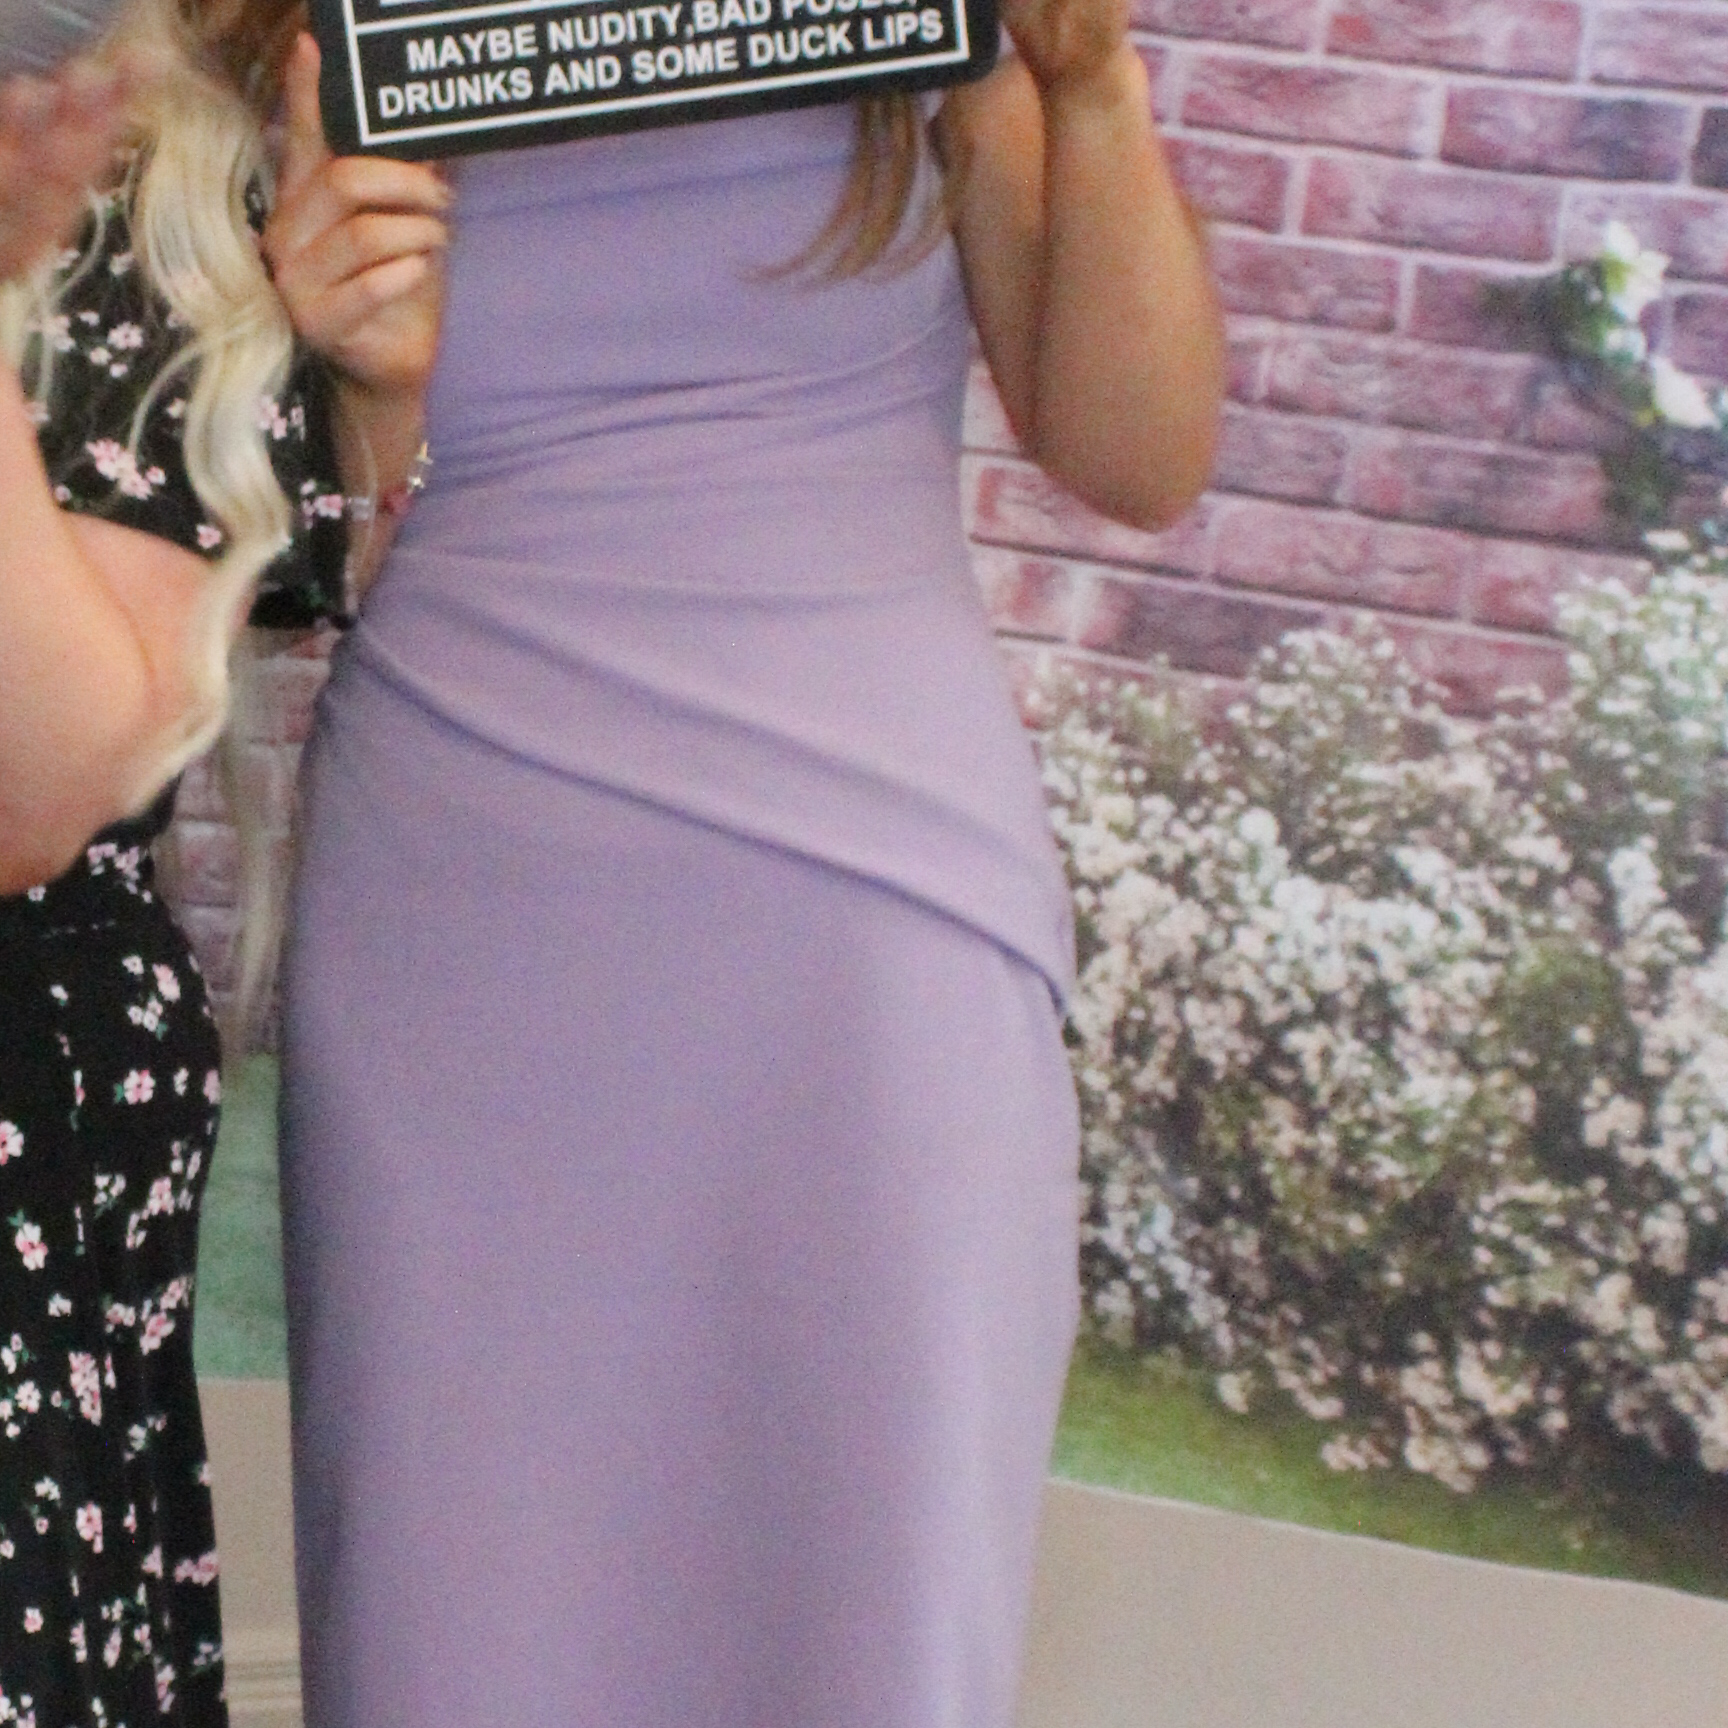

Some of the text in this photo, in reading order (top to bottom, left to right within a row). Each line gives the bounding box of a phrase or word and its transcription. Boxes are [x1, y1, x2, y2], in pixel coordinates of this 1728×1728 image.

[378, 7, 944, 119] DRUNKS AND SOME DUCK LIPS
[406, 23, 539, 73] MAYBE
